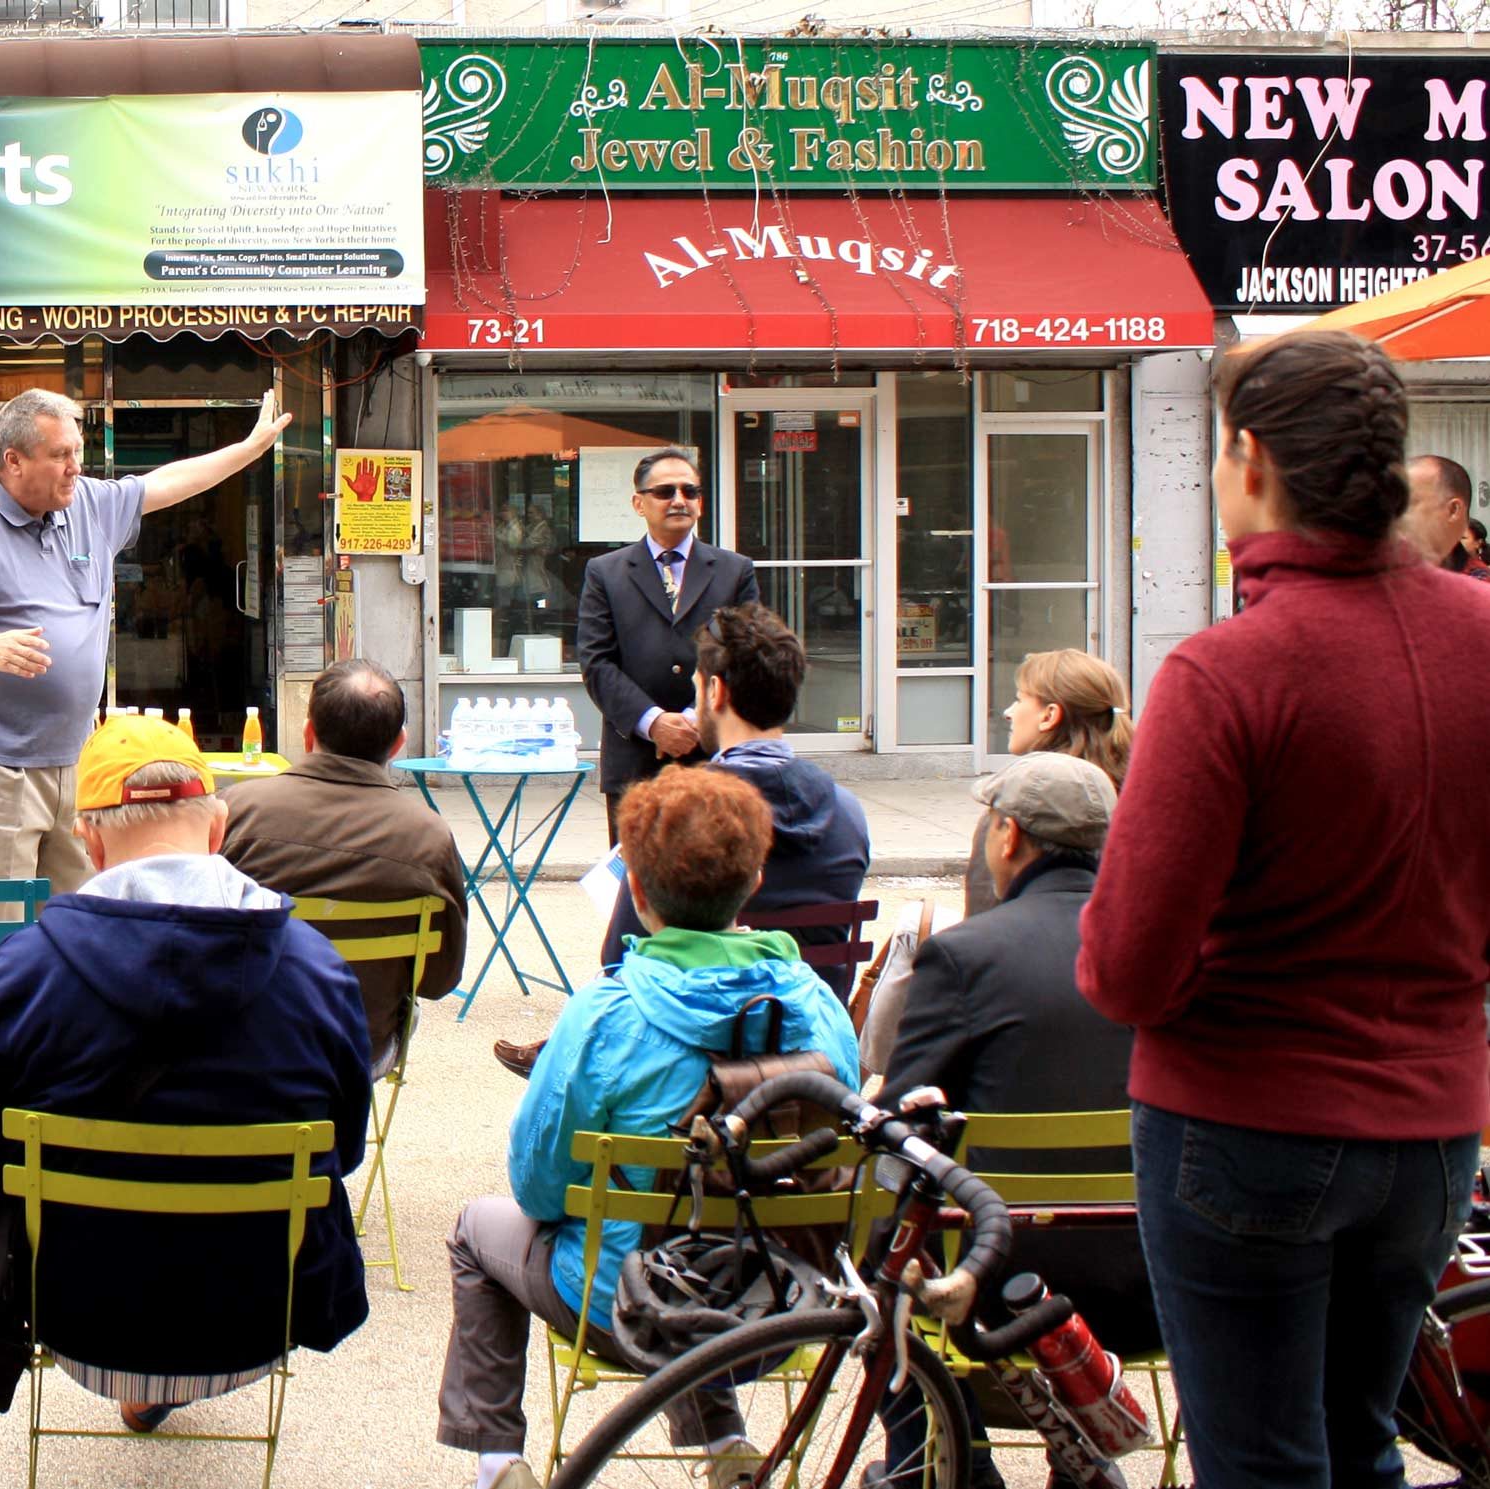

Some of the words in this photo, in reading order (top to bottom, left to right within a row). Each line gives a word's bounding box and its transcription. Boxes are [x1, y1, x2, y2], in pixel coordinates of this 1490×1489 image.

[769, 52, 788, 61] 786
[639, 62, 920, 124] Al-Muqsit
[1179, 76, 1372, 141] NEW
[1424, 78, 1488, 142] M
[570, 127, 712, 173] Jewel
[727, 127, 775, 173] &
[789, 127, 986, 173] Fashion
[225, 157, 318, 184] sukhi
[271, 185, 309, 193] YORK
[1214, 157, 1485, 222] SALON
[230, 203, 286, 220] Diversity
[289, 205, 313, 216] into
[316, 204, 339, 216] One
[150, 225, 181, 234] Stands
[182, 225, 195, 234] for
[198, 225, 224, 234] Social
[256, 225, 305, 235] knowledge
[307, 225, 324, 233] and
[327, 225, 350, 235] Hope
[352, 224, 397, 233] Initiatives
[151, 237, 166, 245] For
[168, 237, 183, 245] the
[185, 237, 216, 247] people
[217, 237, 227, 245] of
[315, 236, 336, 244] York
[338, 236, 345, 244] is
[347, 236, 369, 244] their
[371, 236, 395, 244] home
[217, 254, 237, 263] Scan,
[238, 254, 259, 263] Copy,
[260, 253, 284, 262] Photo,
[285, 253, 308, 261] Small
[308, 253, 342, 261] Business
[344, 252, 380, 260] Solutions
[644, 225, 960, 289] Al-Muqsit
[161, 265, 208, 276] Parent's
[210, 264, 276, 278] Community
[278, 264, 334, 277] Computer
[336, 264, 387, 277] Learning
[1237, 267, 1332, 303] JACKSON
[42, 306, 113, 330] WORD
[120, 305, 268, 328] PROCESSING
[274, 305, 290, 324] &
[296, 305, 327, 323] PC
[334, 304, 412, 323] REPAIR
[972, 317, 1166, 343] 718-424-1188
[467, 318, 544, 344] 73-21
[340, 538, 412, 550] 917-226-4293
